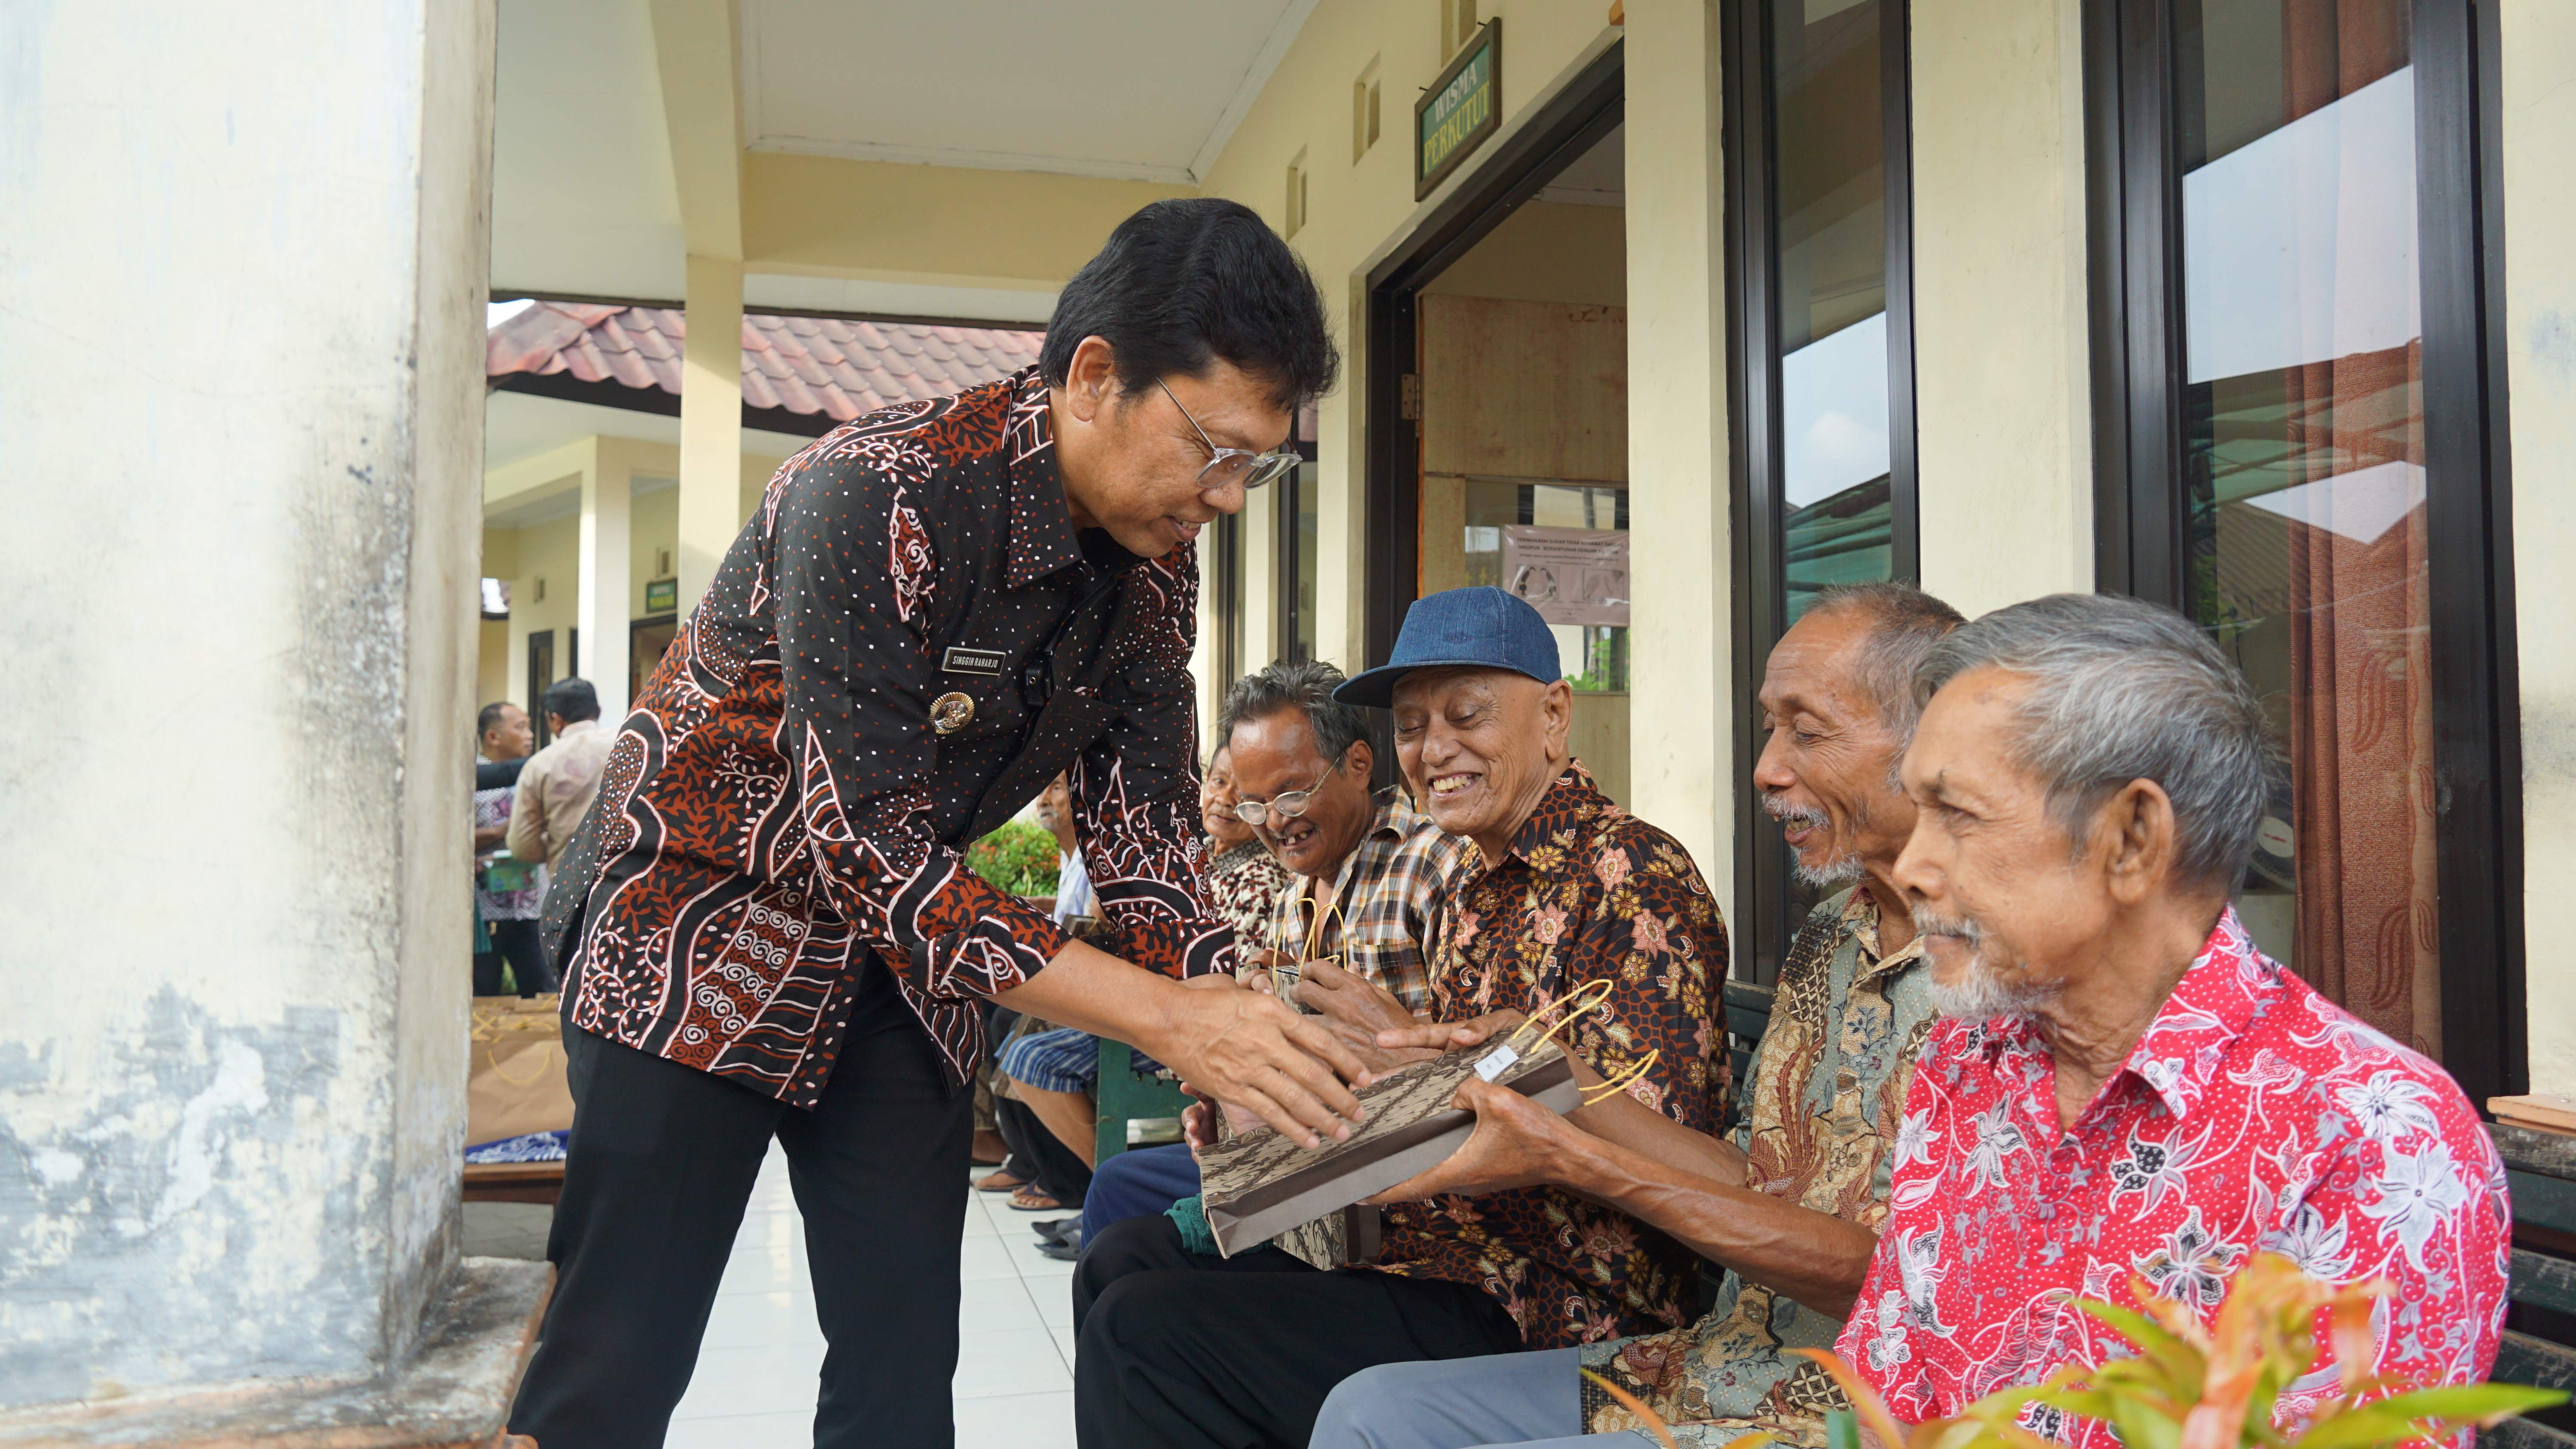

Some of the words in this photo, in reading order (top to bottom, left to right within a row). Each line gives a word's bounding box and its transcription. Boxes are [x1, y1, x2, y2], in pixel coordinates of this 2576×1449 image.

[1434, 62, 1477, 123] WISMA
[1424, 80, 1490, 173] PERKUTUT
[952, 655, 975, 666] SINGGIH
[974, 657, 998, 668] RAHARJO
